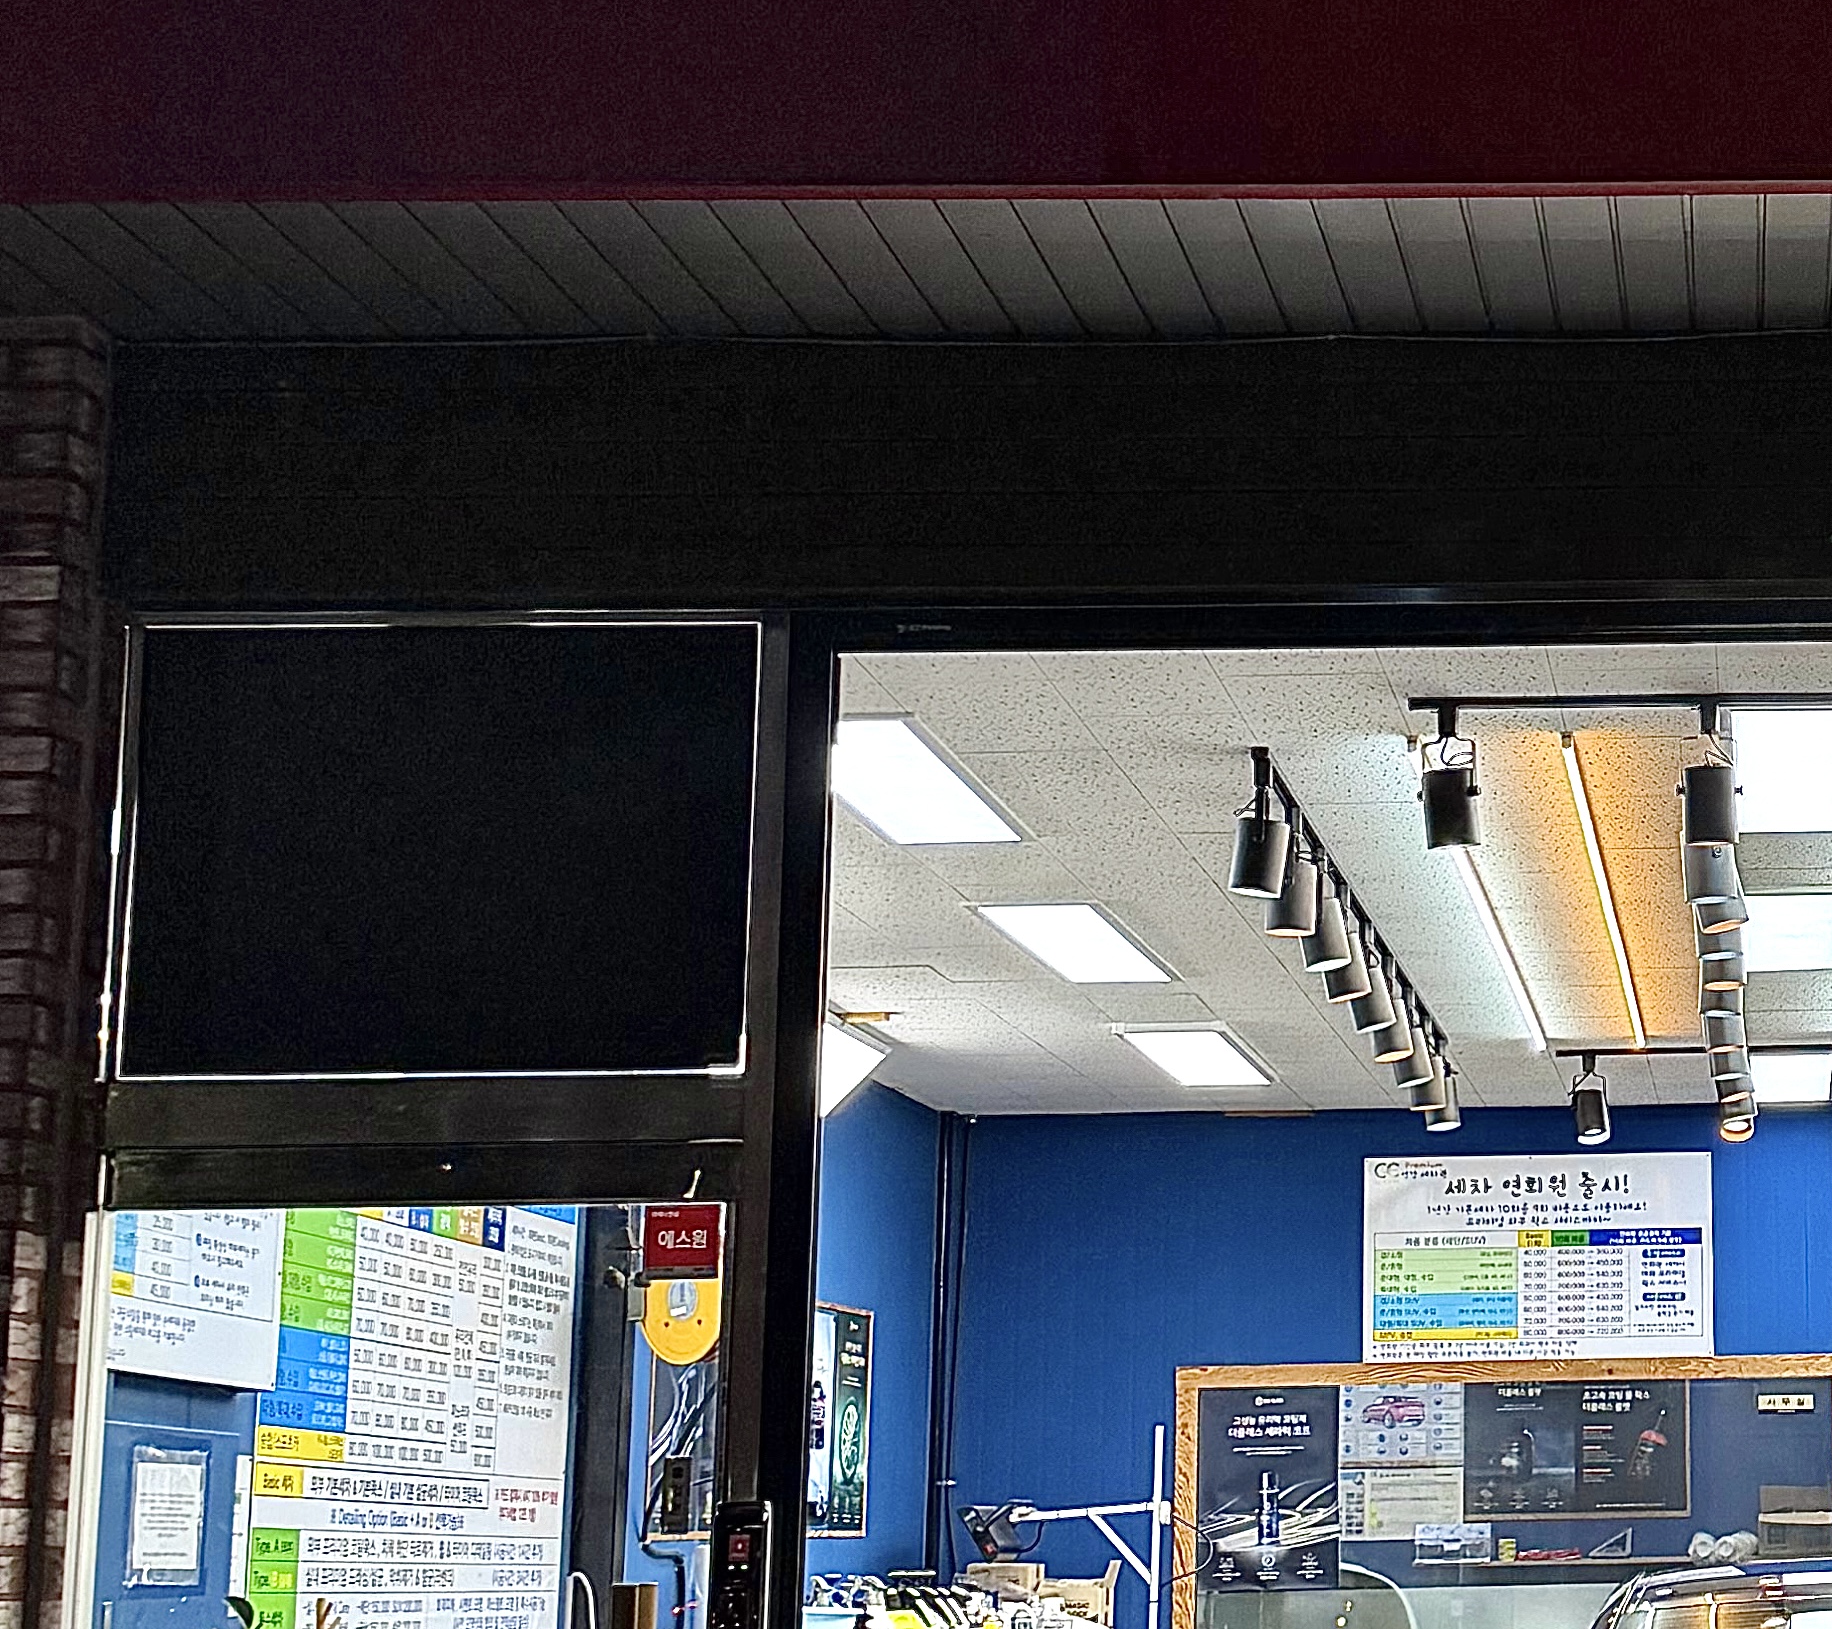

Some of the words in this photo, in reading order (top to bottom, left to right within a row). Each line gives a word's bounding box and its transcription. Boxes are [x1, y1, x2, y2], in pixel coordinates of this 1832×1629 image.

[1445, 1178, 1492, 1195] 세차
[1502, 1174, 1567, 1198] 연회원
[1578, 1171, 1630, 1199] 출시!
